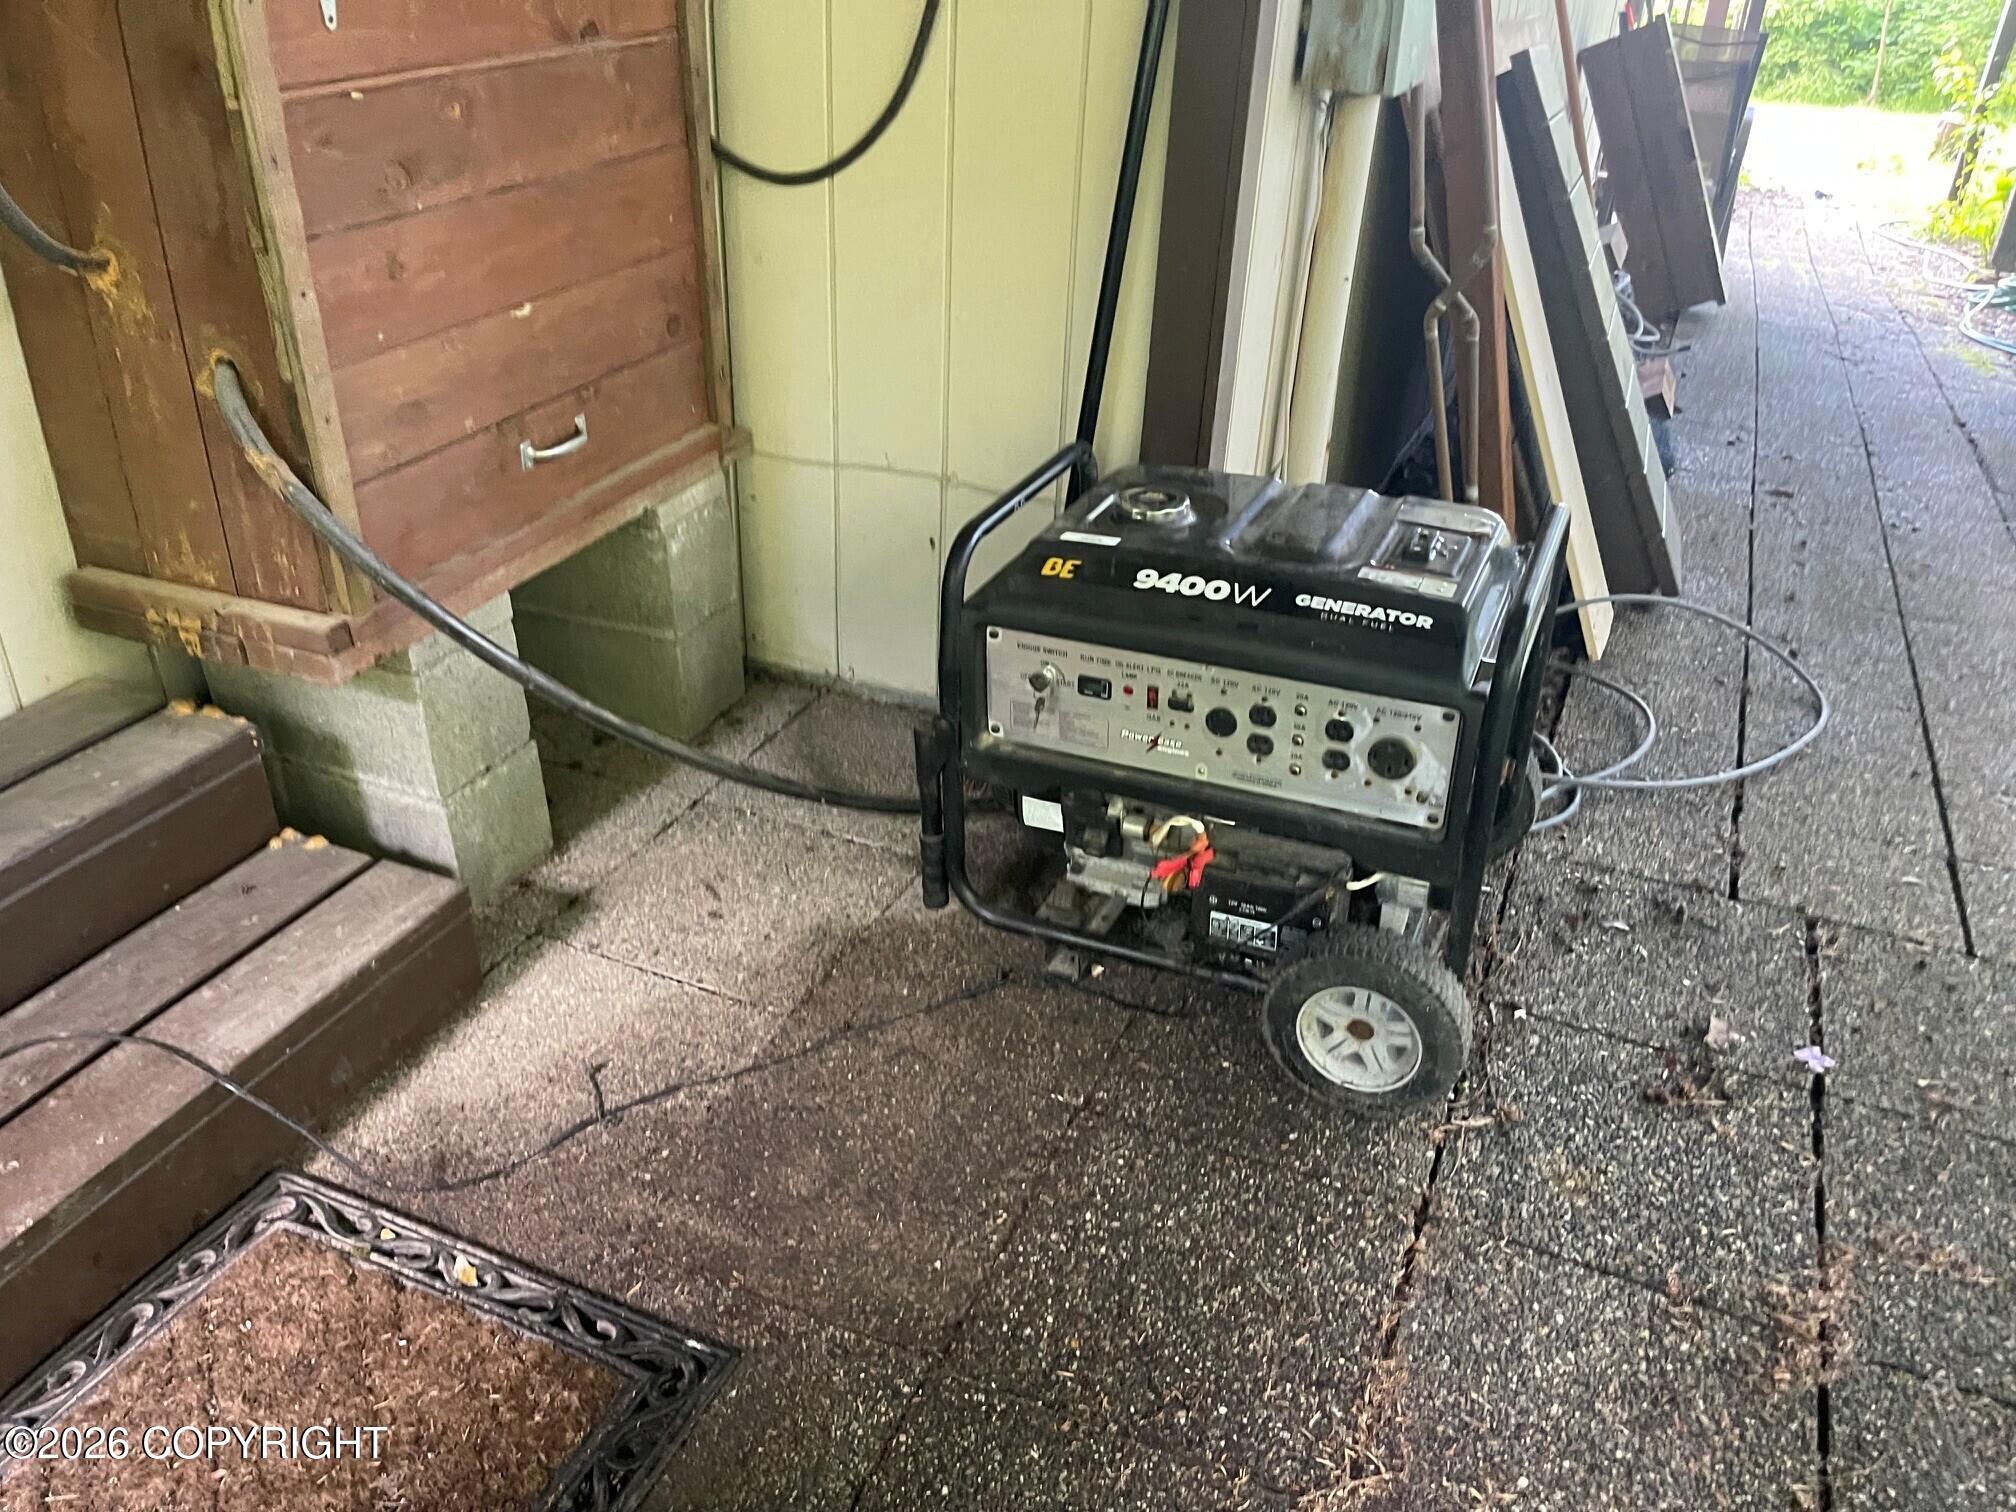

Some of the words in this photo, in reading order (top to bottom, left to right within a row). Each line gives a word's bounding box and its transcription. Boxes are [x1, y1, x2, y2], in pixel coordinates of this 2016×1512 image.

[1041, 557, 1082, 579] BE
[1295, 594, 1434, 630] GENERATOR
[1320, 611, 1354, 625] DUAL
[1361, 618, 1394, 633] FUEL
[1120, 729, 1155, 746] Power
